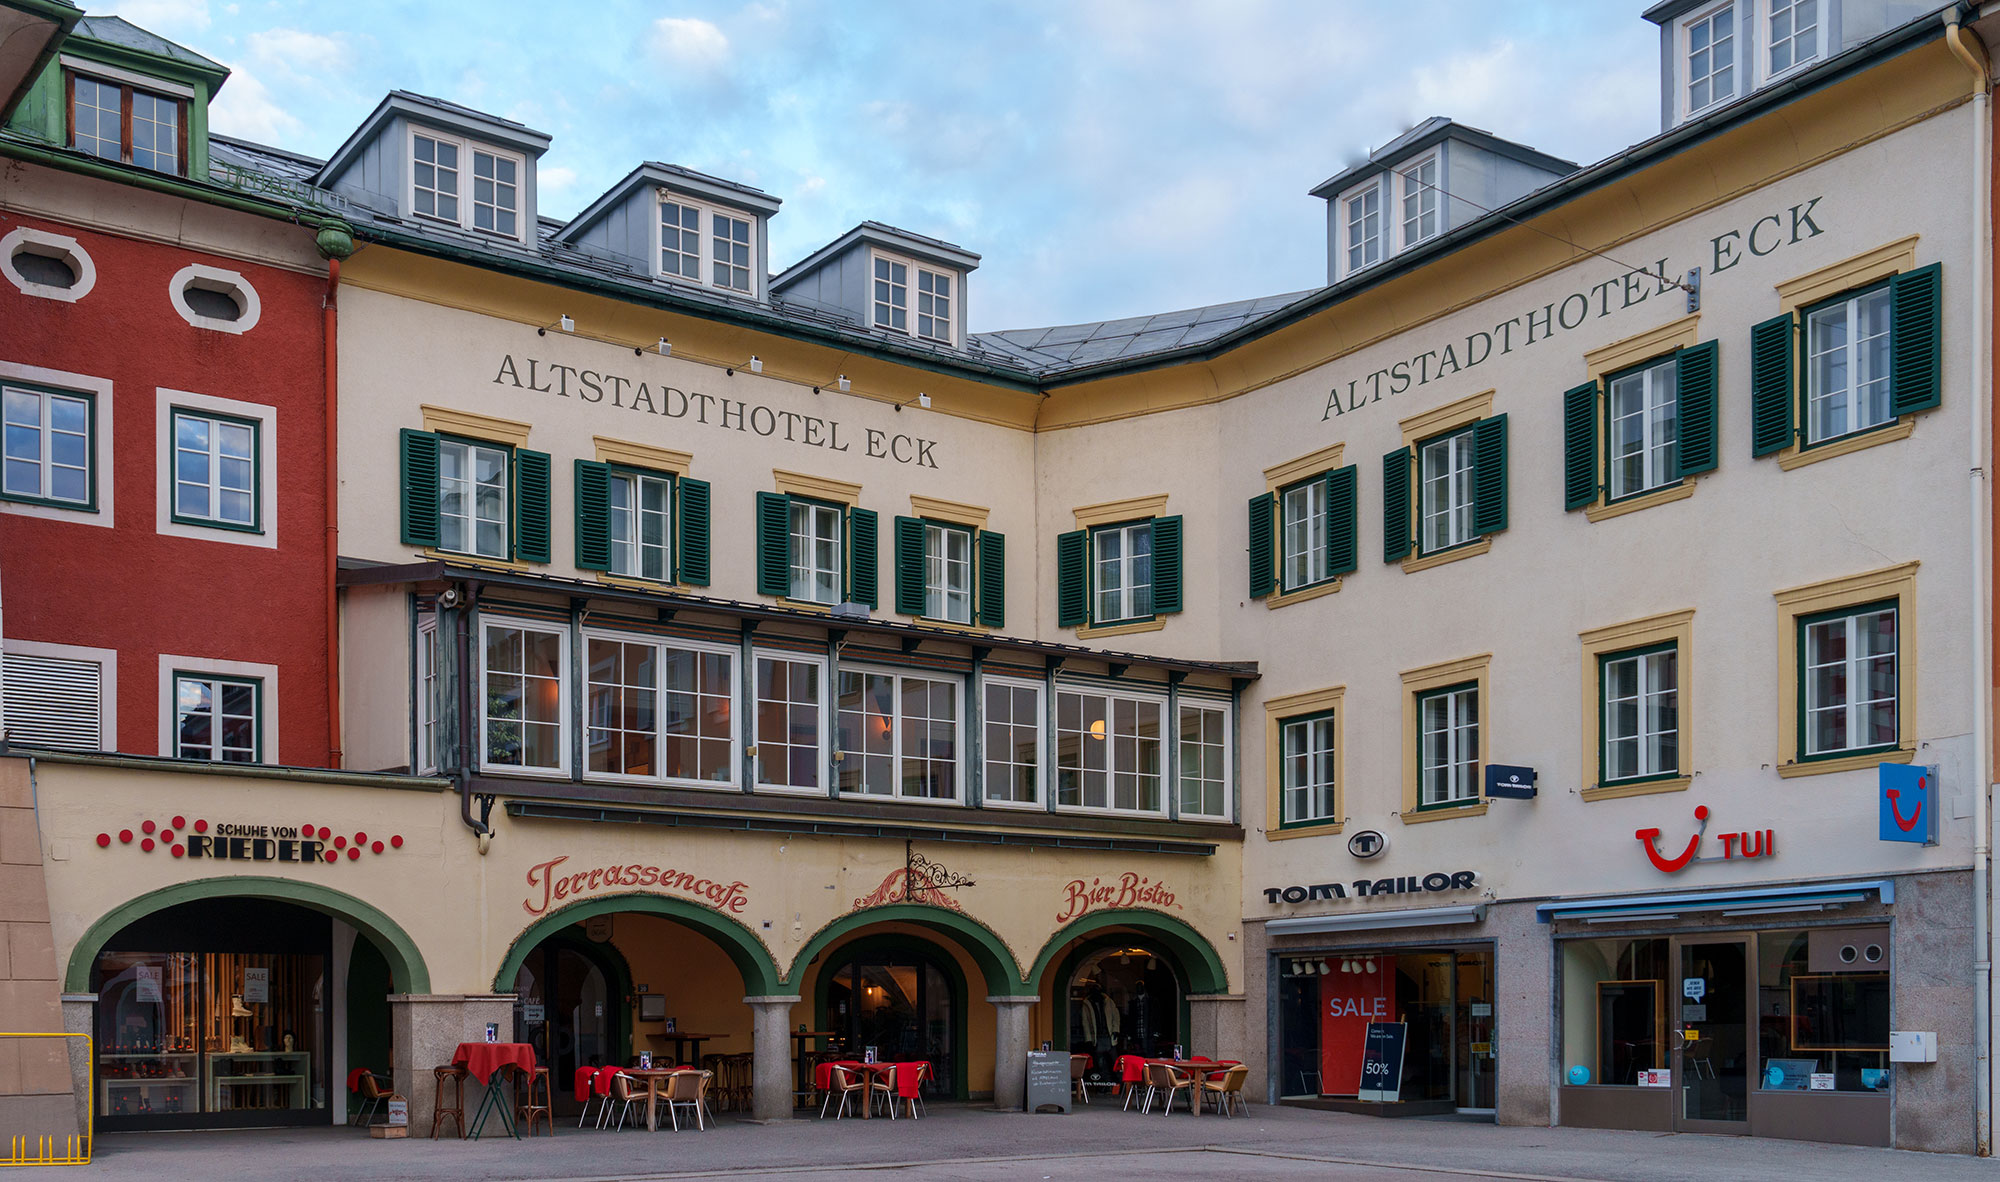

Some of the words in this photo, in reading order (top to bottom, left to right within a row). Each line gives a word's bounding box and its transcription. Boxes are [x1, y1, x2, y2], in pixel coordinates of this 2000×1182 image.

[1320, 256, 1682, 422] ALTSTADTHOTEL
[1709, 196, 1825, 275] ECK
[492, 354, 850, 452] ALTSTADTHOTEL
[864, 428, 940, 470] ECK
[216, 823, 268, 837] SCHUHE
[271, 826, 298, 838] VON
[188, 835, 325, 862] RIEDER
[1717, 829, 1774, 860] TUI
[1056, 877, 1116, 924] Bier
[1108, 871, 1184, 911] Bistro
[1263, 882, 1348, 904] TOM
[1352, 870, 1478, 897] TAILOR
[138, 971, 160, 980] SALE
[246, 972, 266, 981] SALE
[1330, 997, 1387, 1017] SALE
[1365, 1062, 1389, 1075] 50%
